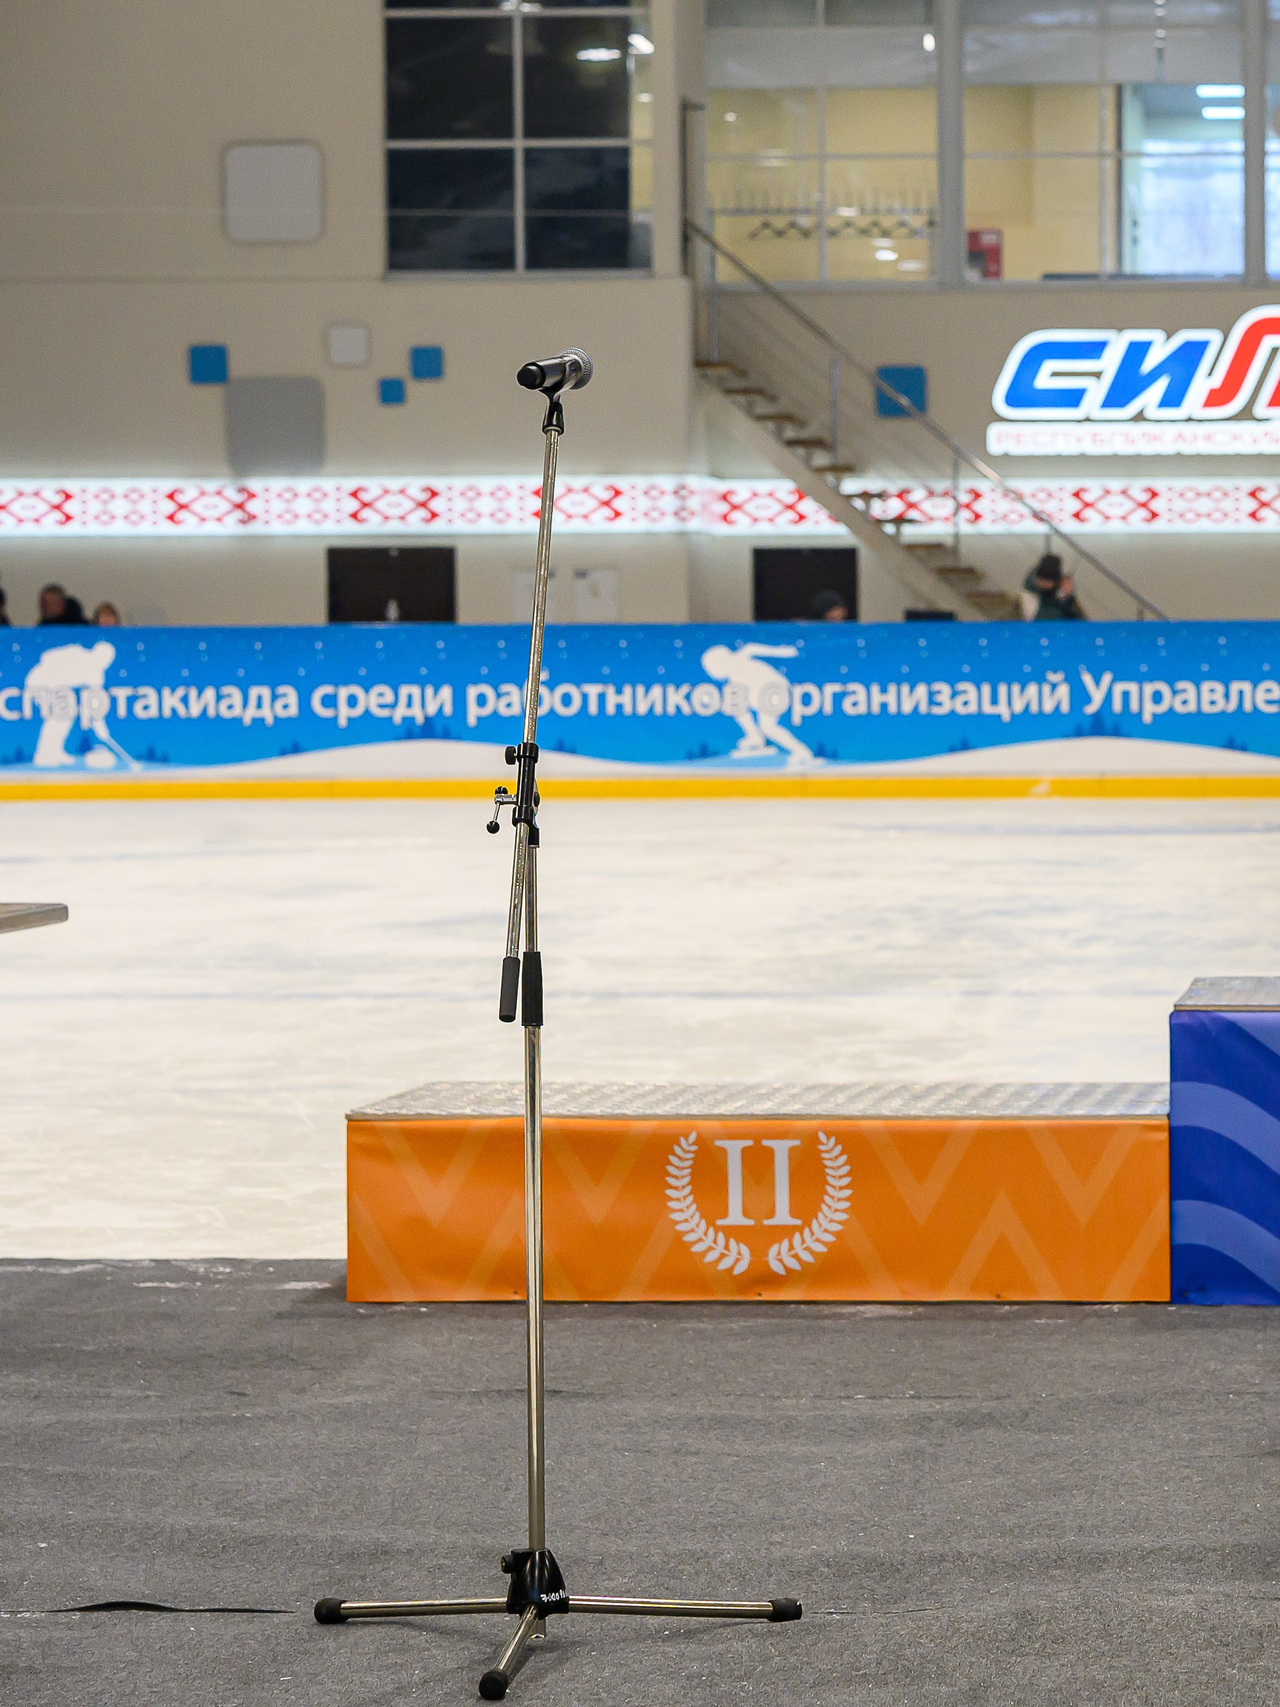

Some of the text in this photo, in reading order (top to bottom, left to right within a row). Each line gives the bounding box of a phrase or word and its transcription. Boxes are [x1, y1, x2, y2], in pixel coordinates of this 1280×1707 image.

[0, 683, 300, 730] спартакиада
[310, 682, 454, 728] среди
[465, 667, 751, 728] работников
[757, 670, 1070, 726] организаций
[714, 1139, 802, 1226] II
